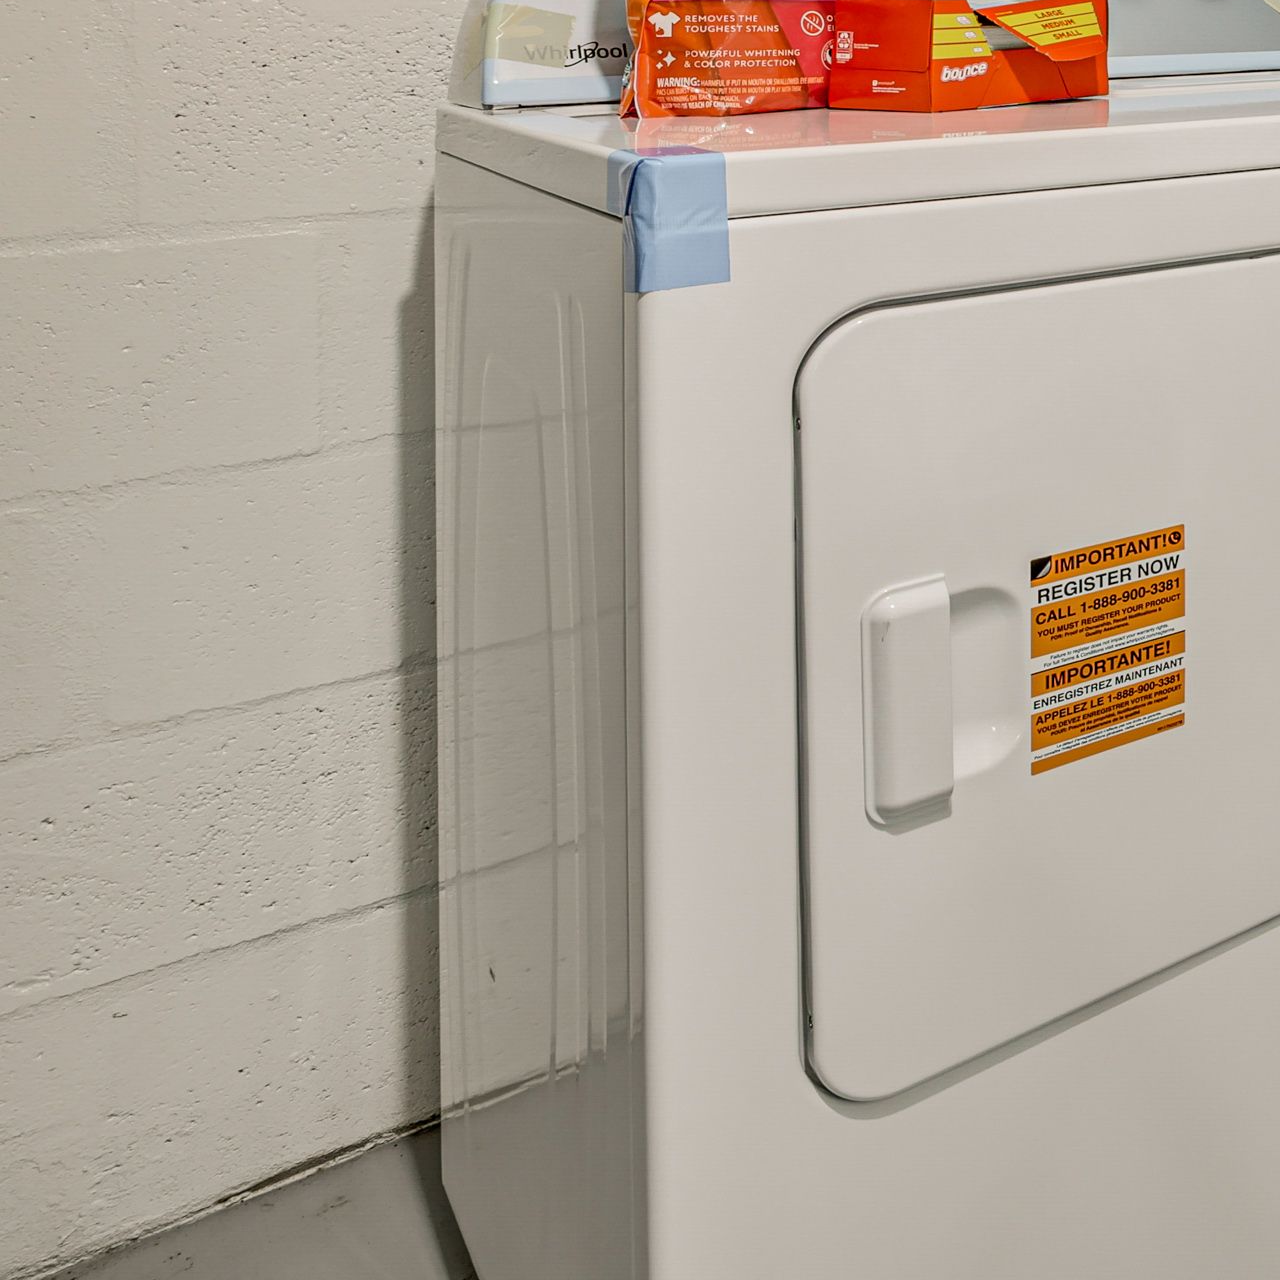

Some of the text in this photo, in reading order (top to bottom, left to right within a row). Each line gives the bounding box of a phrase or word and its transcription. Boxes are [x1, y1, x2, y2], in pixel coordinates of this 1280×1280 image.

[684, 14, 758, 23] REMOVES THE
[1035, 8, 1064, 19] LARGE
[685, 24, 780, 33] TOUGHEST STAINS
[1041, 19, 1076, 30] MEDIUM
[1053, 29, 1083, 41] SMALL
[685, 48, 801, 58] POWERFUL WHITENING
[684, 59, 796, 68] & COLOR PROTECTION
[940, 61, 989, 82] bounce
[656, 77, 700, 88] WARNING:
[1054, 533, 1167, 574] IMPORTANT!
[1038, 554, 1180, 604] REGISTER NOW
[1035, 577, 1180, 625] CALL 1-888-900-3381
[1037, 593, 1182, 638] YOU MUST REGISTER YOUR PRODUCT
[1064, 629, 1078, 638] Proof
[1085, 628, 1102, 638] Quality
[1050, 651, 1066, 659] Failure
[1110, 635, 1126, 644] impact
[1045, 640, 1170, 690] IMPORTANTE!
[1033, 657, 1184, 710] ENREGISTREZ MAINTENANT
[1035, 673, 1181, 726] APPELEZ LE 1-888-900-3381
[1037, 684, 1182, 735] VOUS DEVEZ ENREGISTRER VOTRE PRODUIT
